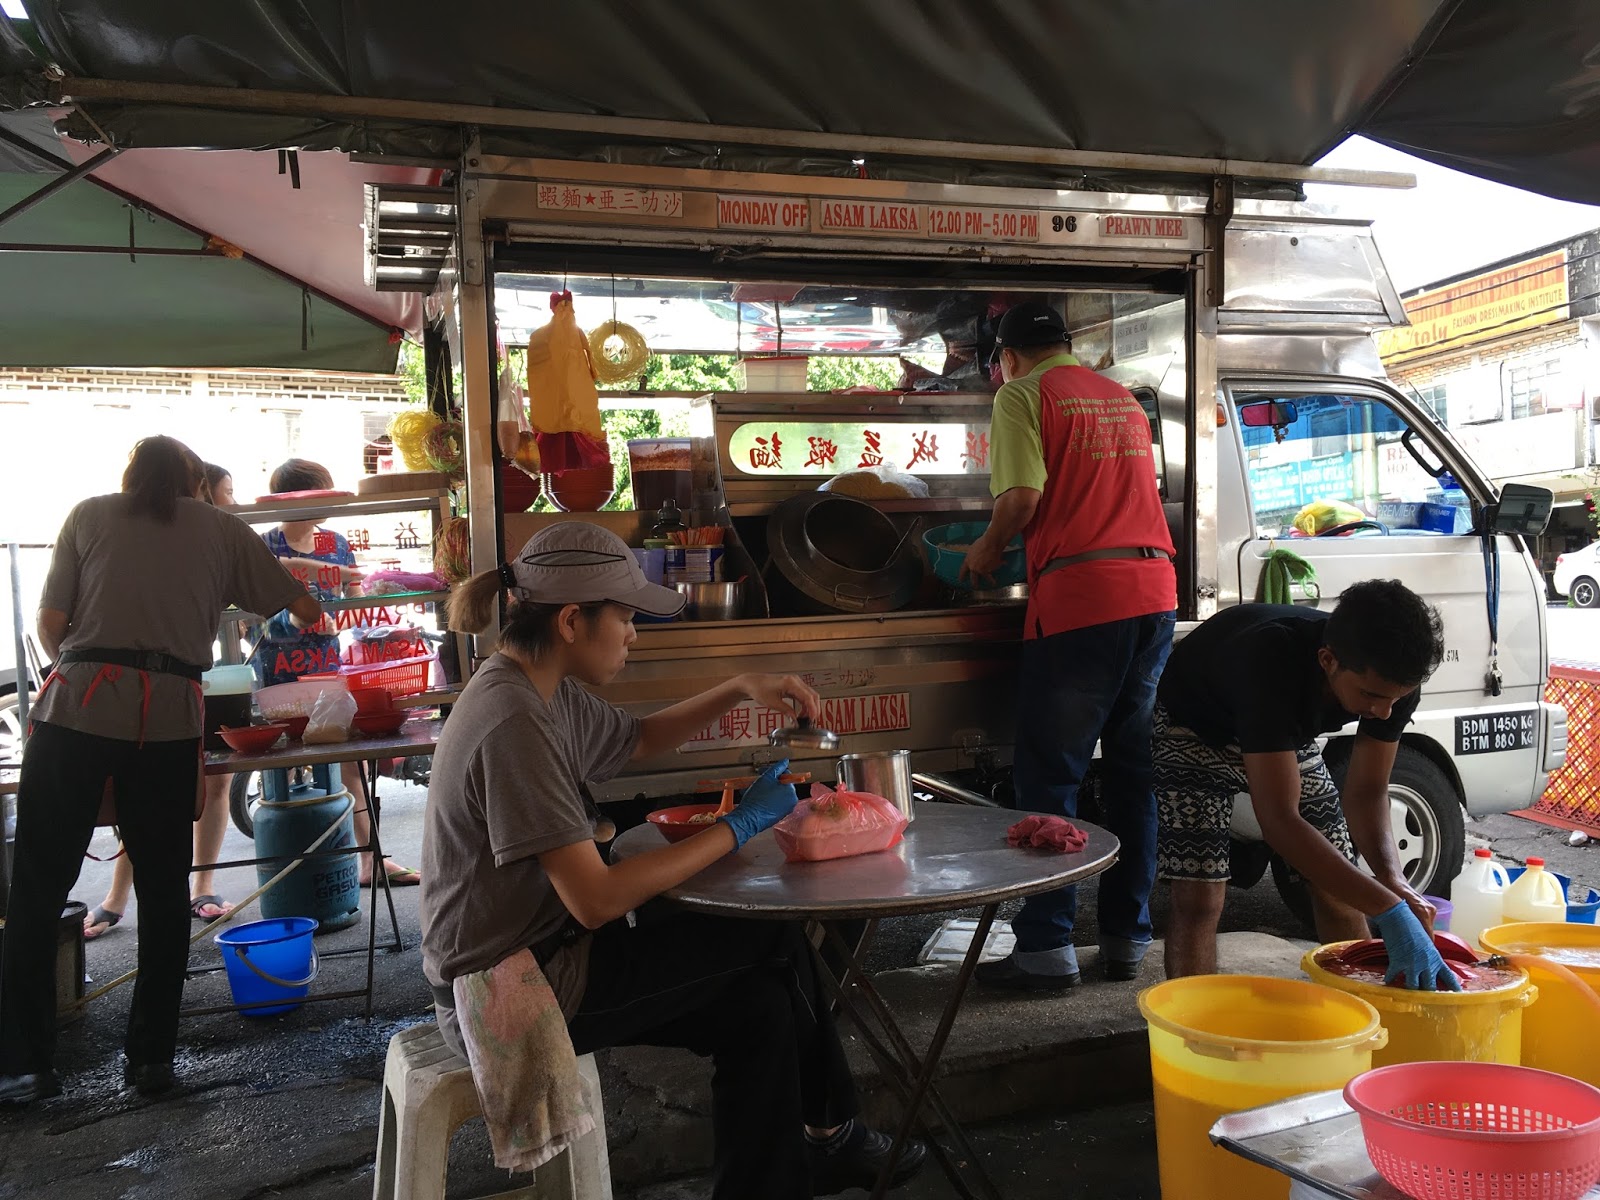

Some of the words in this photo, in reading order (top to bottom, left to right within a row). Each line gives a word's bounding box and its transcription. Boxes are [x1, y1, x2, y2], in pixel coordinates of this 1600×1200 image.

[720, 200, 777, 226] MONDAY
[782, 203, 807, 227] OFF
[823, 204, 867, 229] ASAM
[870, 206, 918, 231] LAKSA
[930, 210, 961, 234] 12.00
[1020, 214, 1037, 238] PM
[1052, 215, 1077, 233] 96
[1106, 217, 1151, 236] PRAWN
[1155, 219, 1183, 237] MEE
[1452, 313, 1477, 330] FASHION
[1480, 300, 1526, 321] DRESSMAKING
[1528, 288, 1563, 310] INSTITUTE
[1107, 397, 1122, 405] PIPE
[1107, 406, 1118, 414] AIR
[1098, 415, 1127, 424] SERVICES
[1377, 504, 1416, 518] PREMIER
[860, 694, 909, 732] LAKSA
[1462, 718, 1489, 736] BDM
[1493, 716, 1518, 732] 1450
[1521, 715, 1533, 730] KG
[1462, 735, 1490, 751] BTM
[1495, 733, 1515, 748] 880
[1521, 731, 1533, 746] KG
